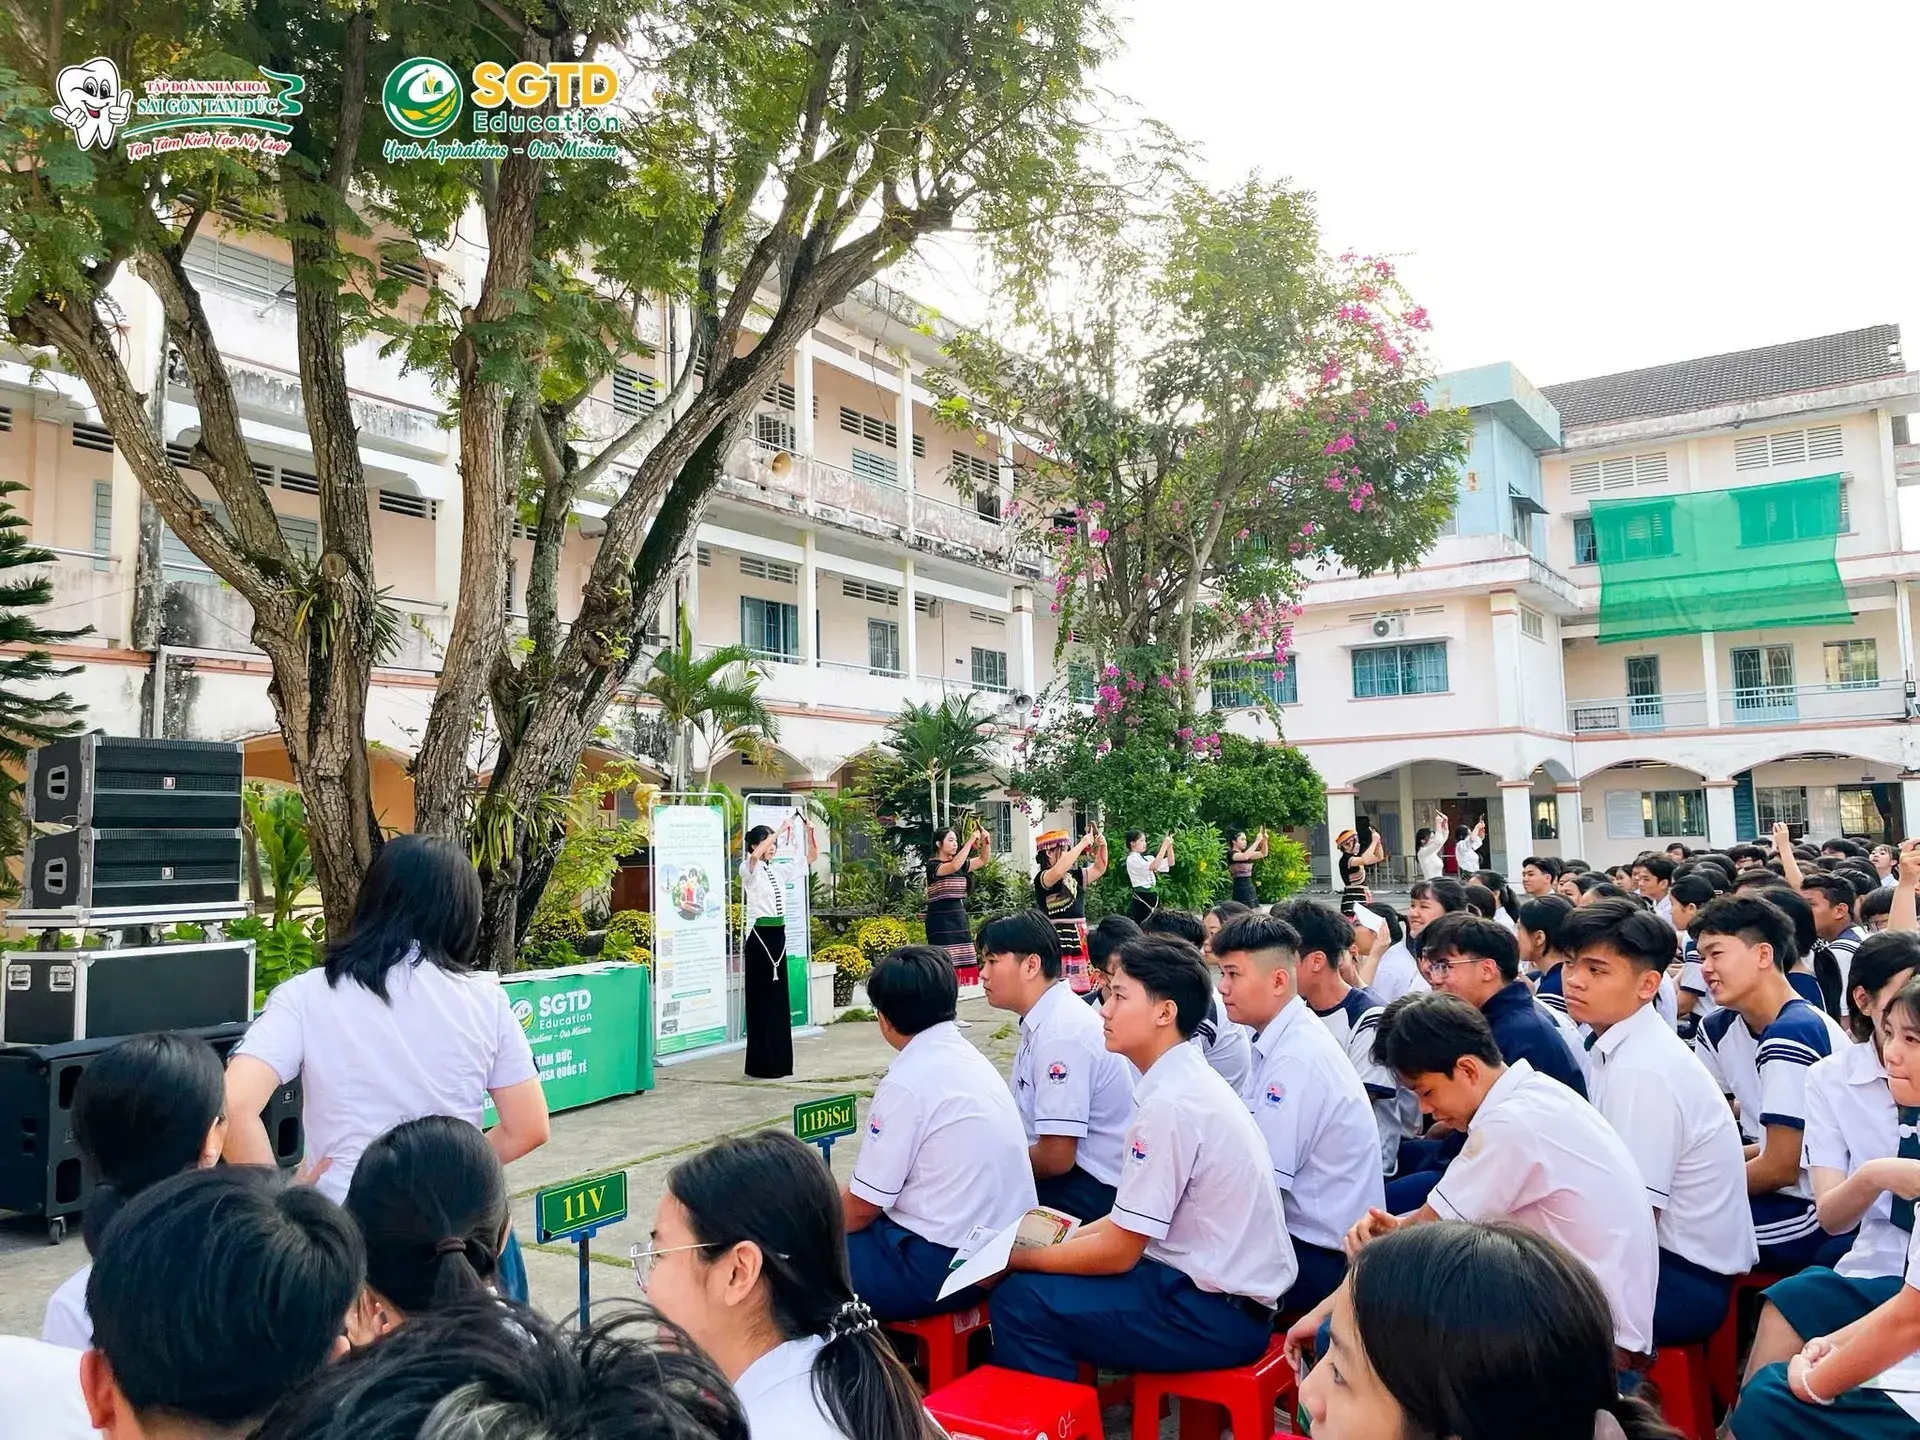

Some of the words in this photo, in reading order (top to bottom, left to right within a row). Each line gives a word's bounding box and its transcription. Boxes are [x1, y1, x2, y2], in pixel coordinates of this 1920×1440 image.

[539, 989, 592, 1017] SGTD
[539, 1013, 592, 1030] Education
[563, 1185, 606, 1222] 11V
